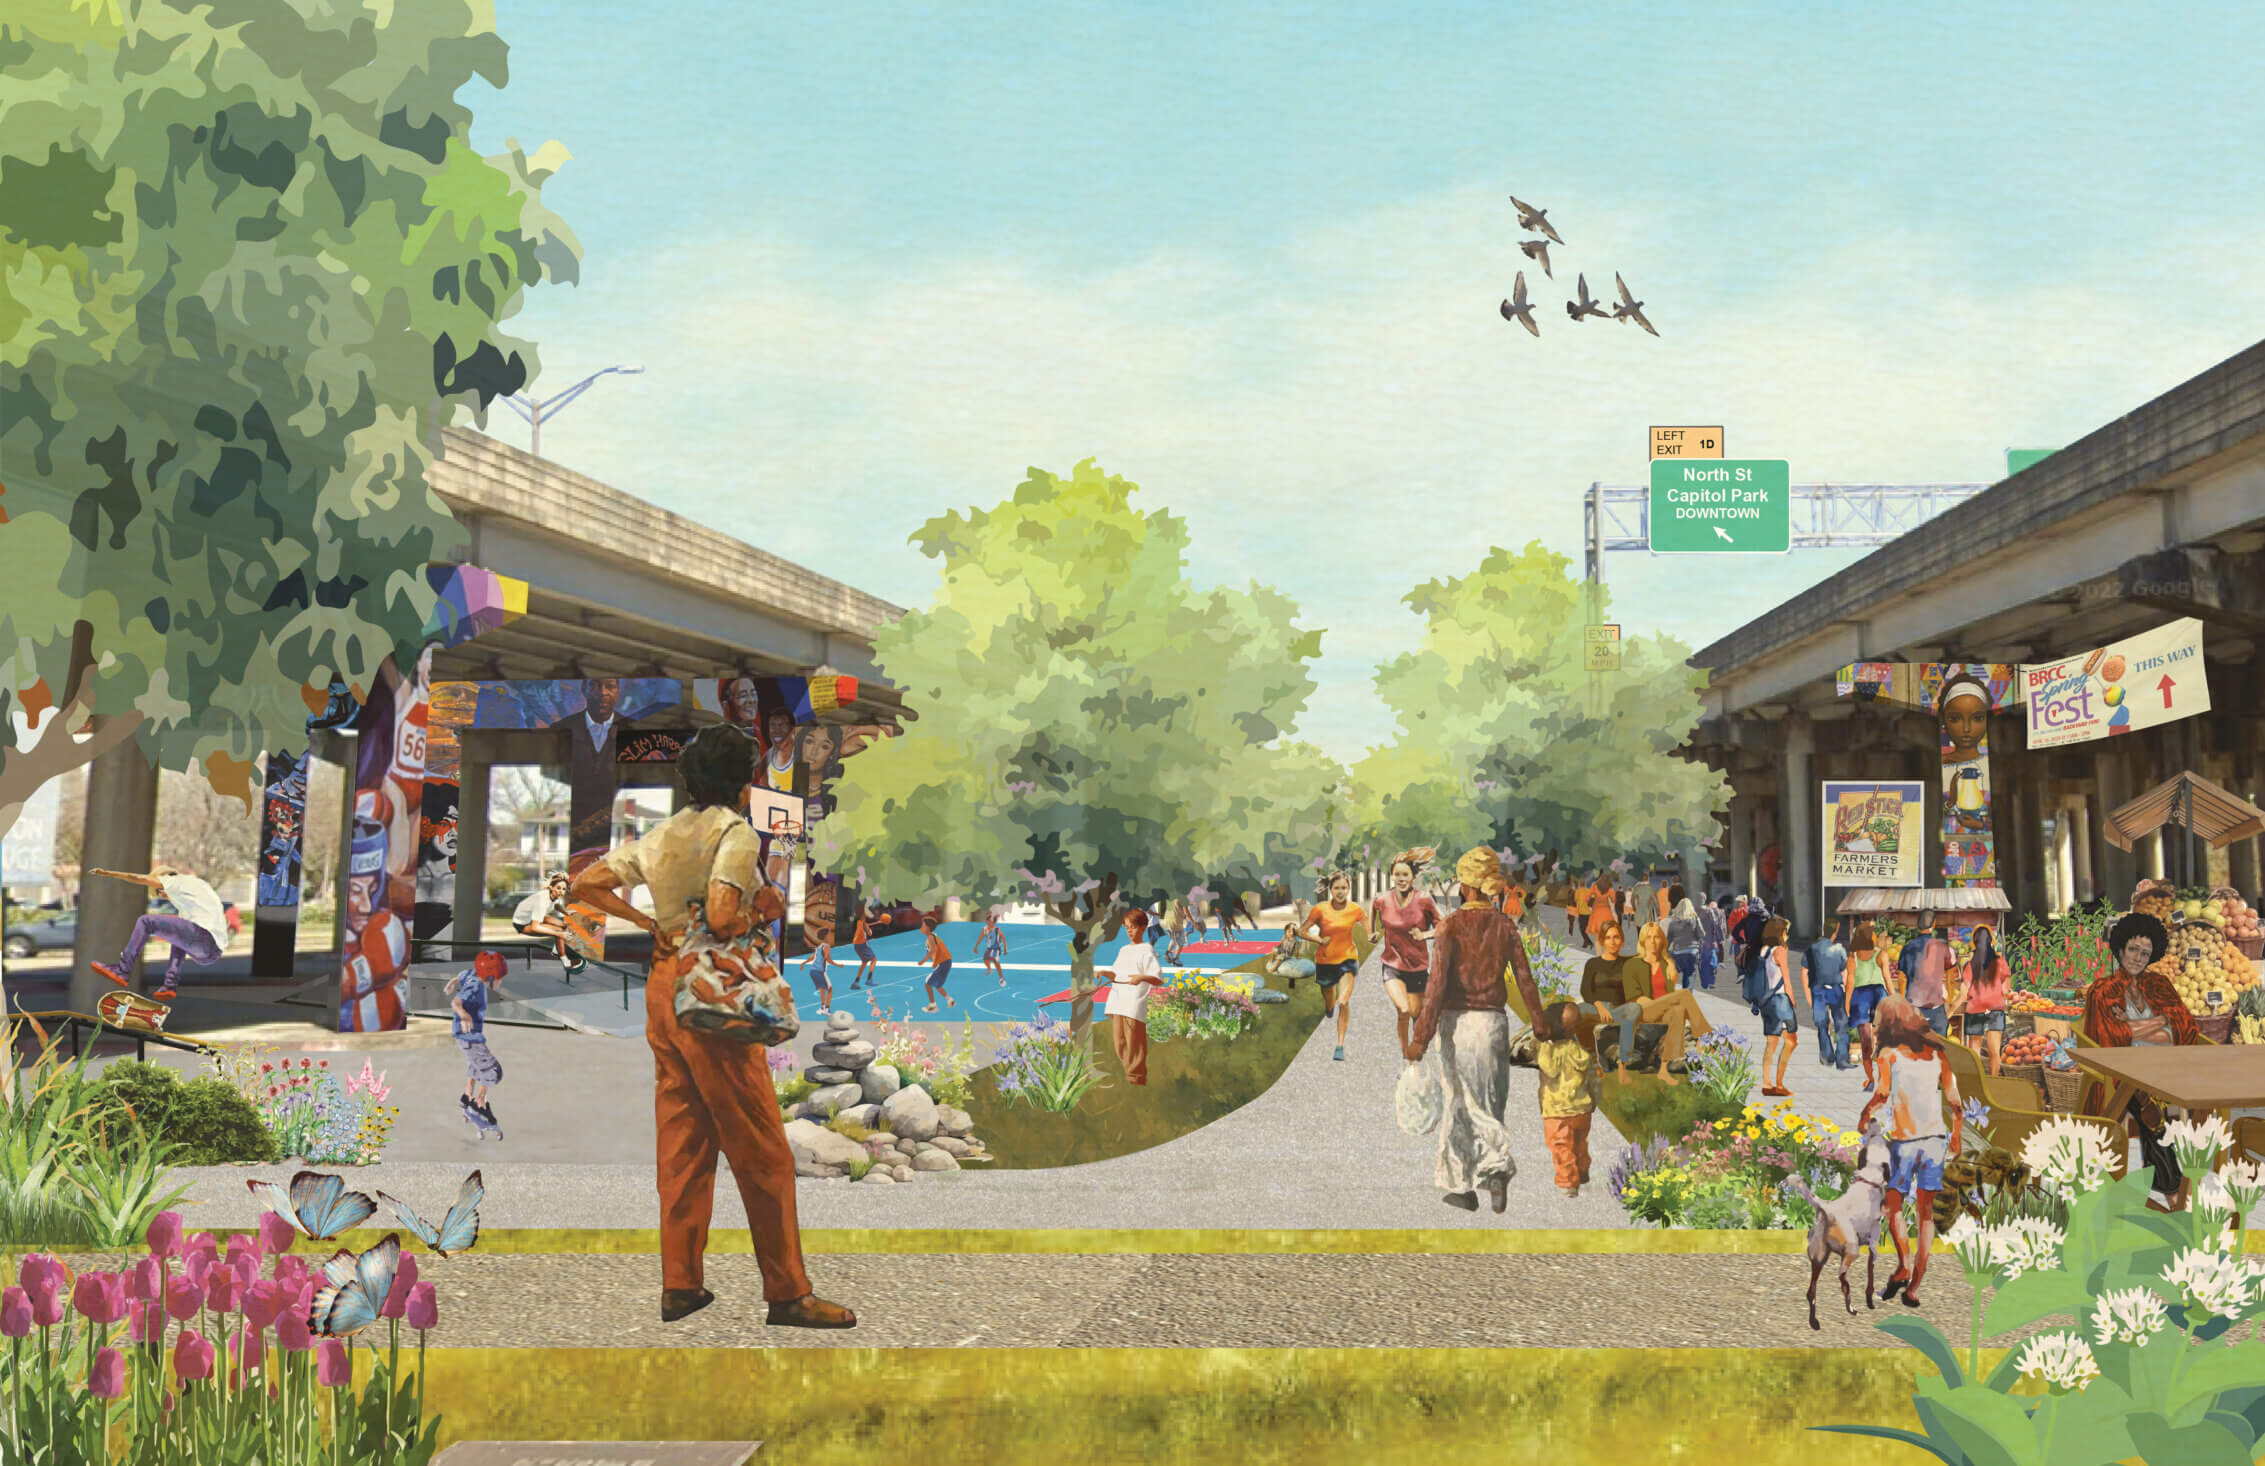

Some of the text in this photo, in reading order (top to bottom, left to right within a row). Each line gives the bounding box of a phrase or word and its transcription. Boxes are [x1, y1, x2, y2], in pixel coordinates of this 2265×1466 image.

[1656, 430, 1685, 441] LEFT
[1656, 445, 1683, 455] EXIT
[1699, 439, 1715, 449] 1D
[1683, 467, 1752, 482] North St
[1666, 488, 1769, 506] Capitol Park
[1675, 507, 1760, 519] DOWNTOWN
[2133, 644, 2197, 673] THIS WAY
[2028, 664, 2067, 688] BRCC
[2039, 672, 2089, 705] Spring
[2030, 686, 2095, 730] Fest
[402, 733, 425, 761] 56
[1833, 853, 1899, 865] FARMERS
[1832, 865, 1898, 877] MARKET
